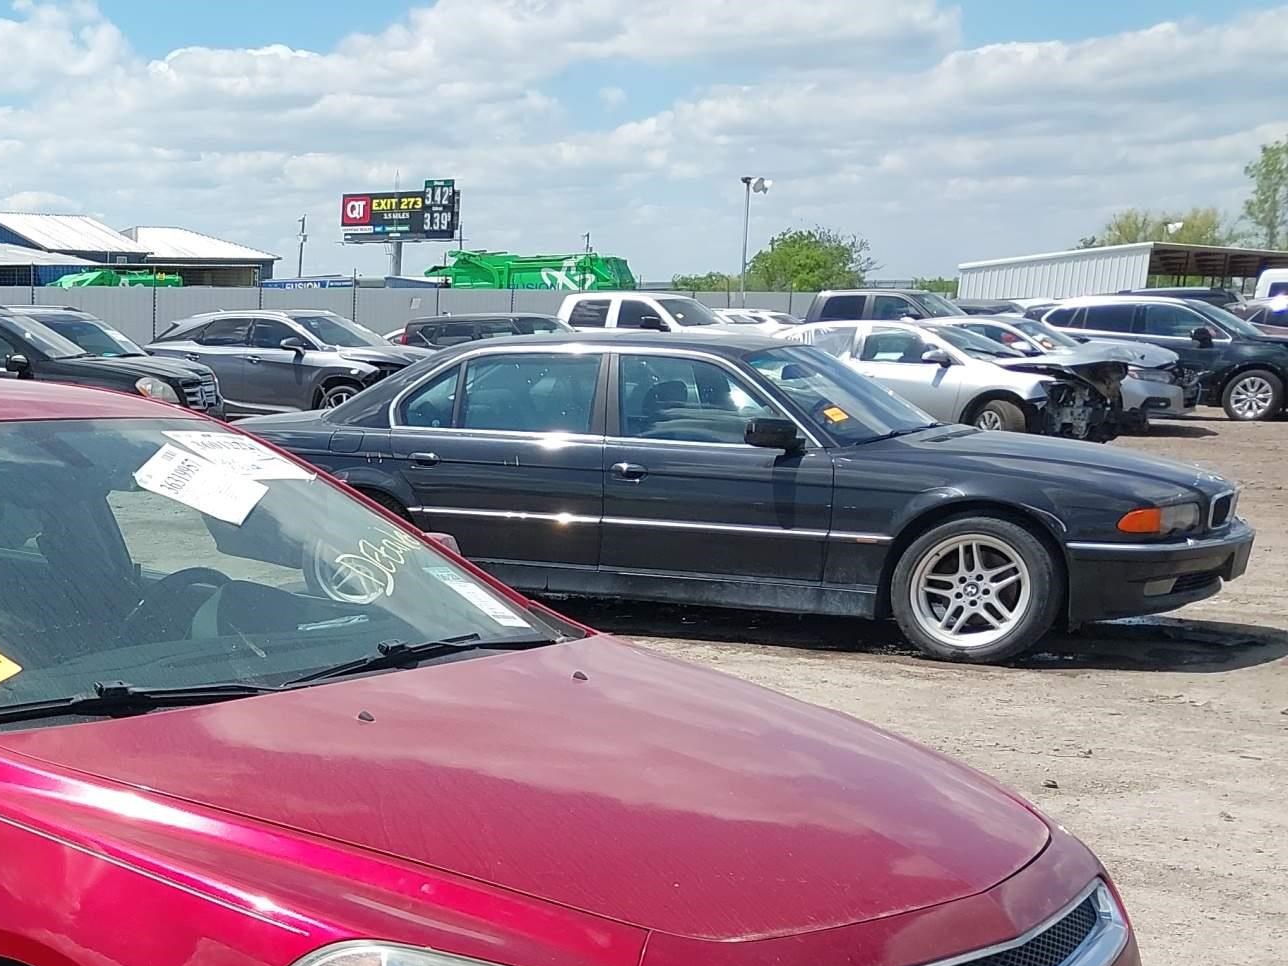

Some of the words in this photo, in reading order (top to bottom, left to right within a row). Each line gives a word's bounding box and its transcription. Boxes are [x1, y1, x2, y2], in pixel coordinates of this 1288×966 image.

[346, 200, 366, 219] QT
[372, 198, 399, 210] EXIT
[400, 197, 423, 209] 273
